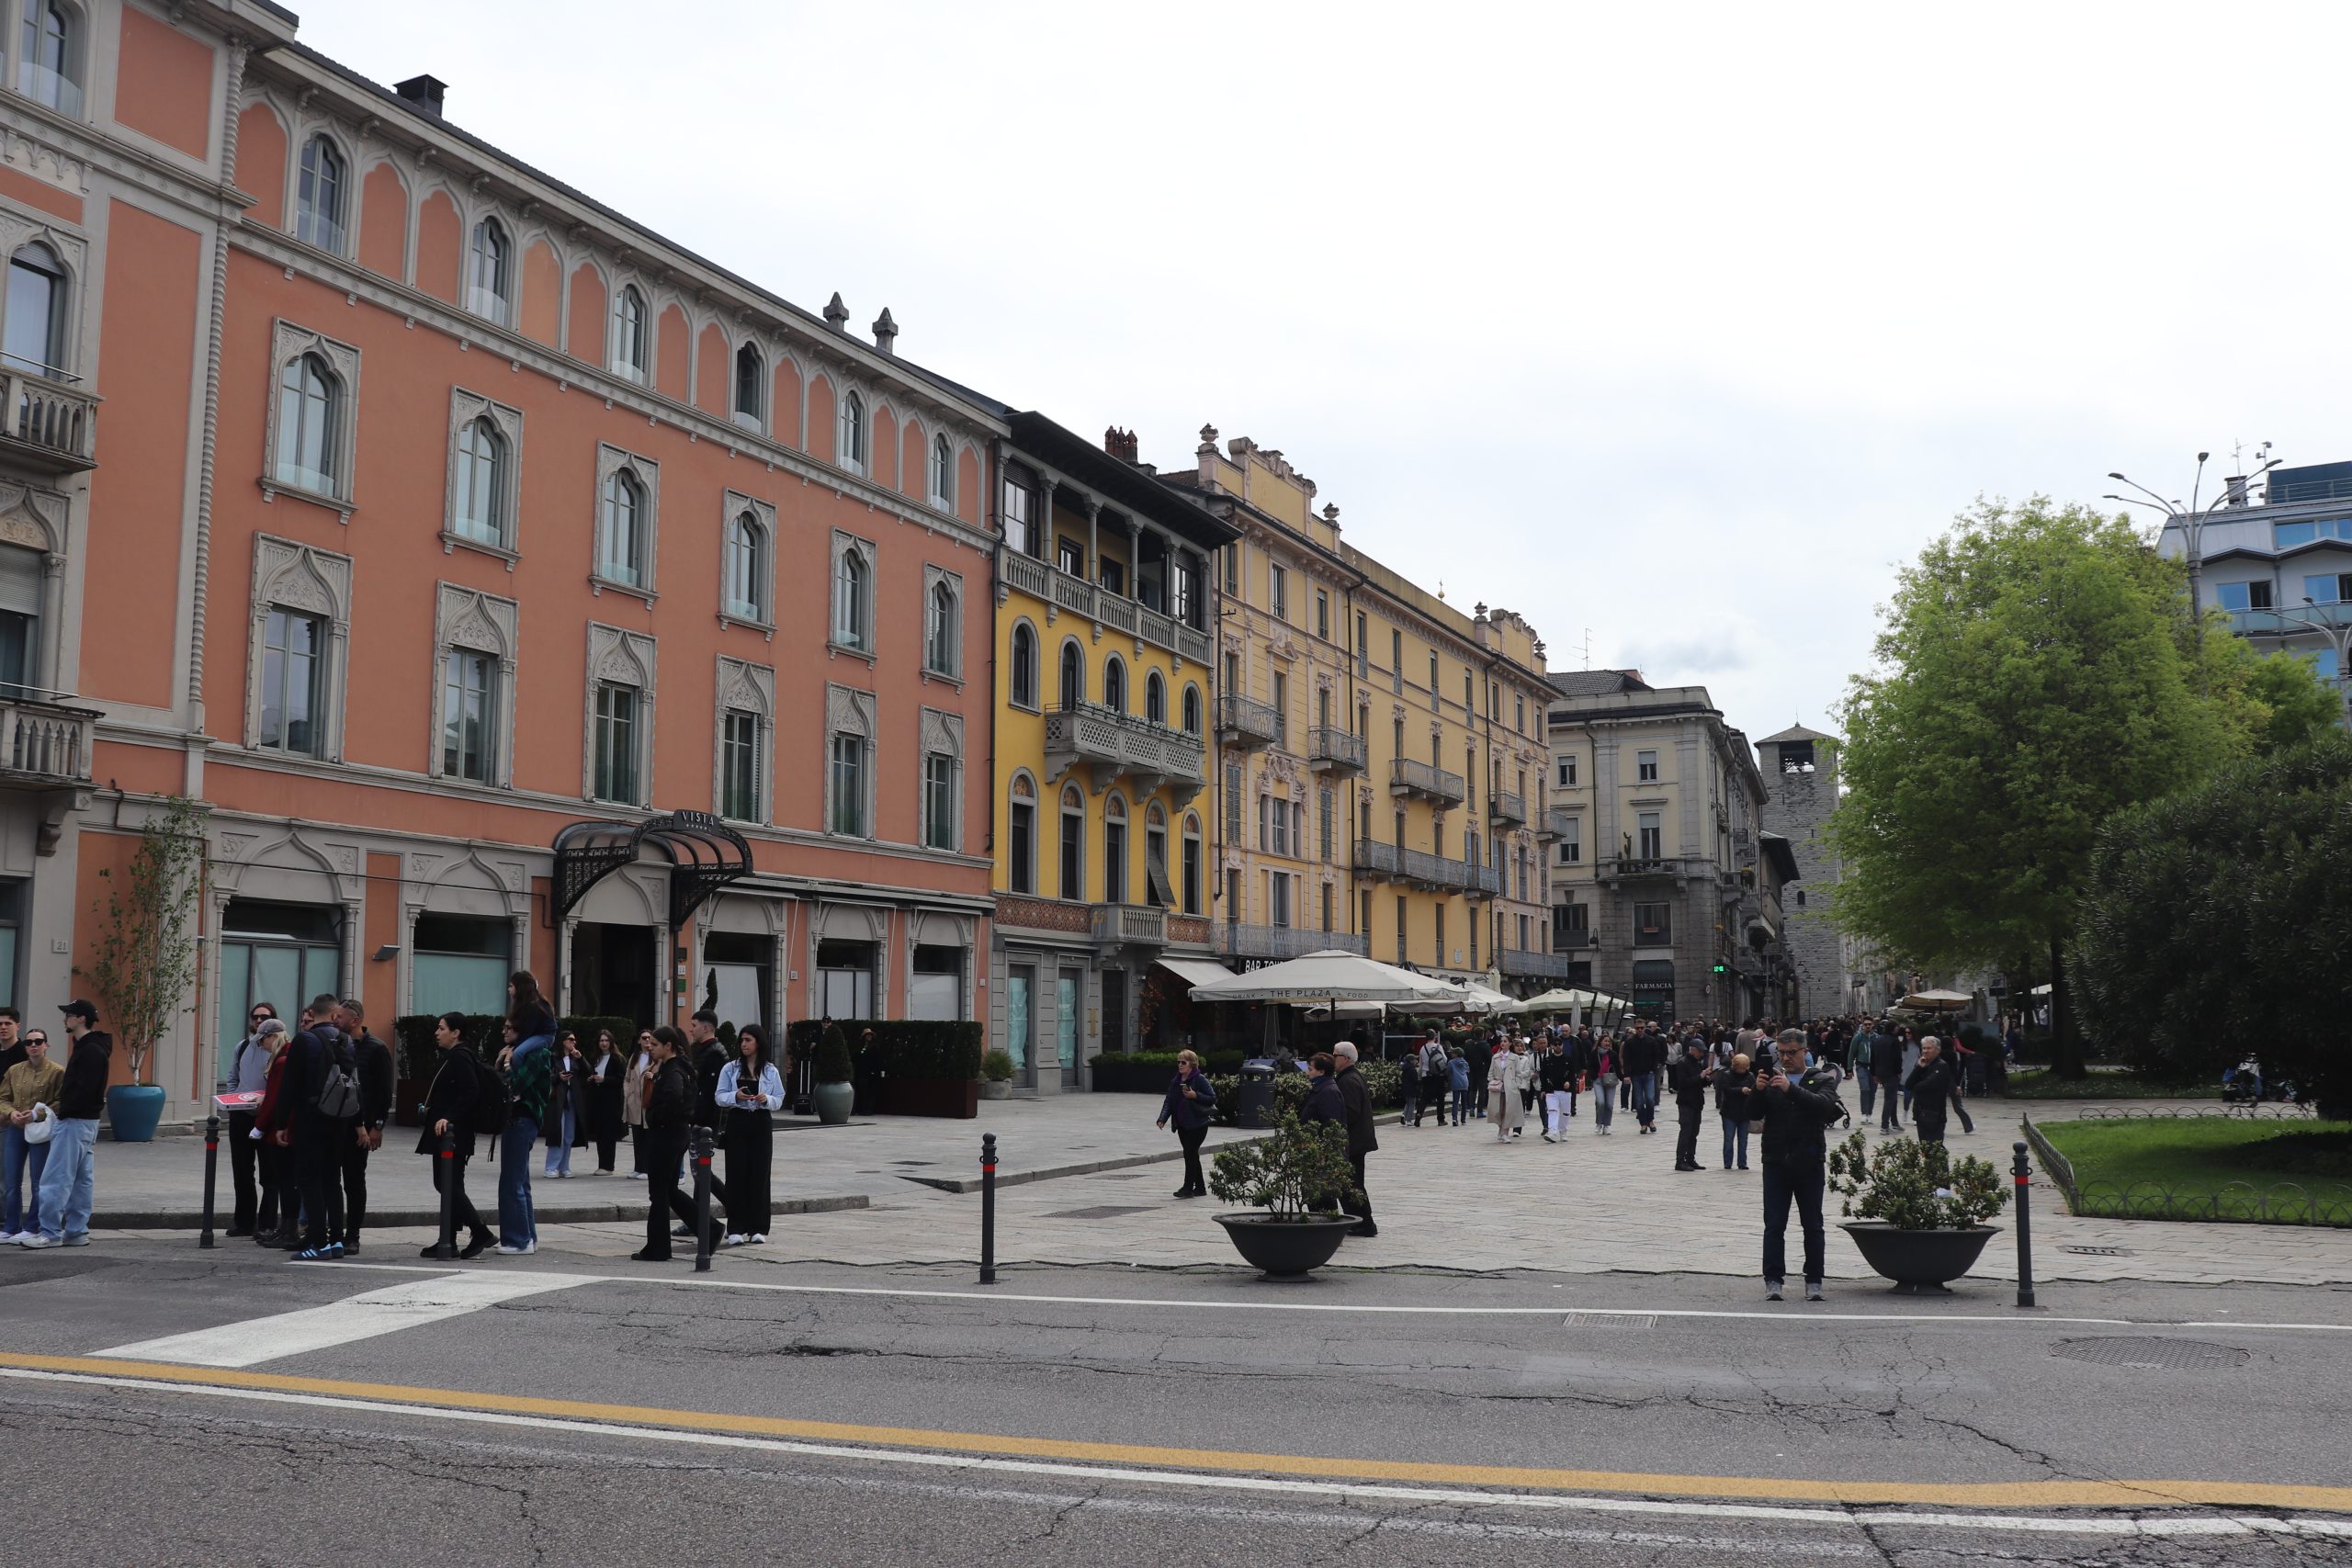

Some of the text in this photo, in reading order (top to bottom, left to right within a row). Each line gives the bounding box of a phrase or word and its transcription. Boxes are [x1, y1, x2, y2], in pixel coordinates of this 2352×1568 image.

[682, 811, 714, 826] VISTA
[57, 941, 66, 950] 21
[1245, 960, 1261, 973] BAR
[1296, 989, 1331, 998] PLAZA
